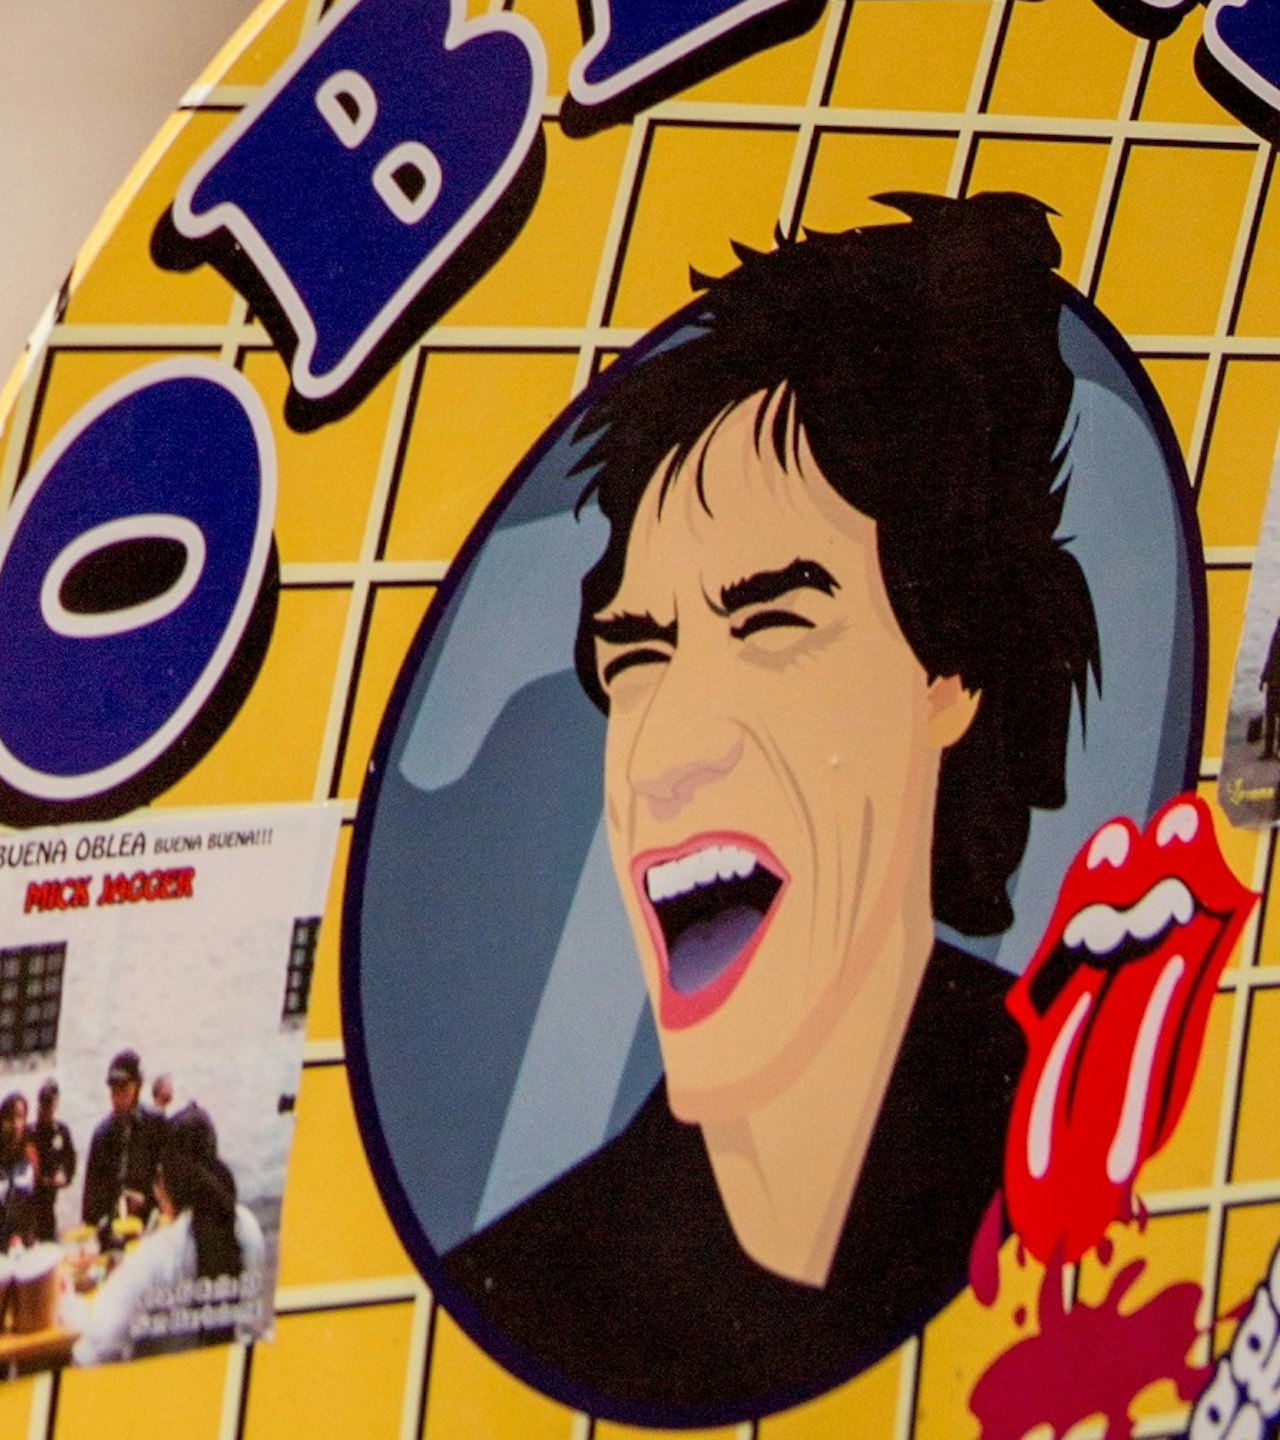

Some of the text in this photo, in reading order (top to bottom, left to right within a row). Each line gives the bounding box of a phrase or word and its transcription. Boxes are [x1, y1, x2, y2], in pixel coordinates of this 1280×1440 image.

[75, 831, 147, 861] OBLEA
[153, 833, 203, 855] BUENA
[23, 866, 196, 914] MICK JAGGER
